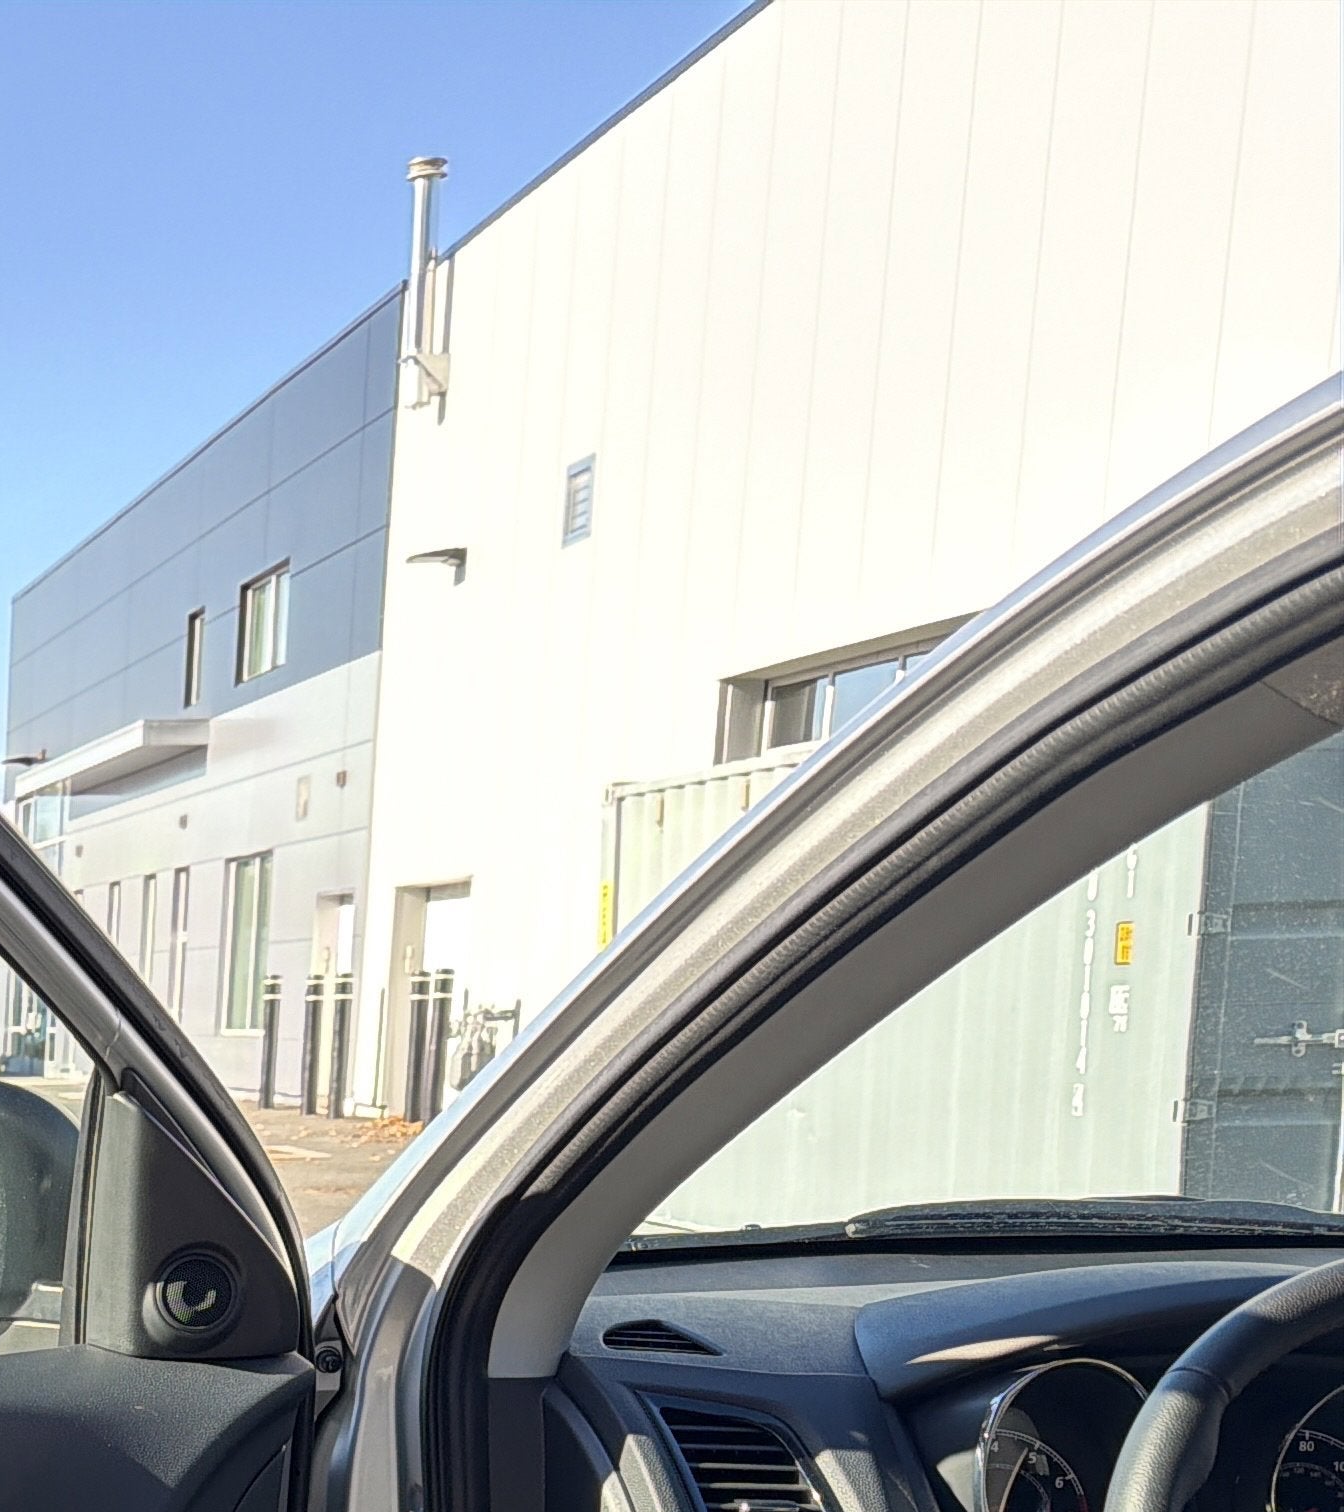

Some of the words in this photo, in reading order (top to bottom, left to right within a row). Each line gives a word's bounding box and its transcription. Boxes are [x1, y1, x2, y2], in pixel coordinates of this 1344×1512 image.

[990, 1440, 999, 1452] 4
[1298, 1440, 1315, 1452] 80
[1027, 1452, 1037, 1464] 5
[1054, 1476, 1064, 1489] 6
